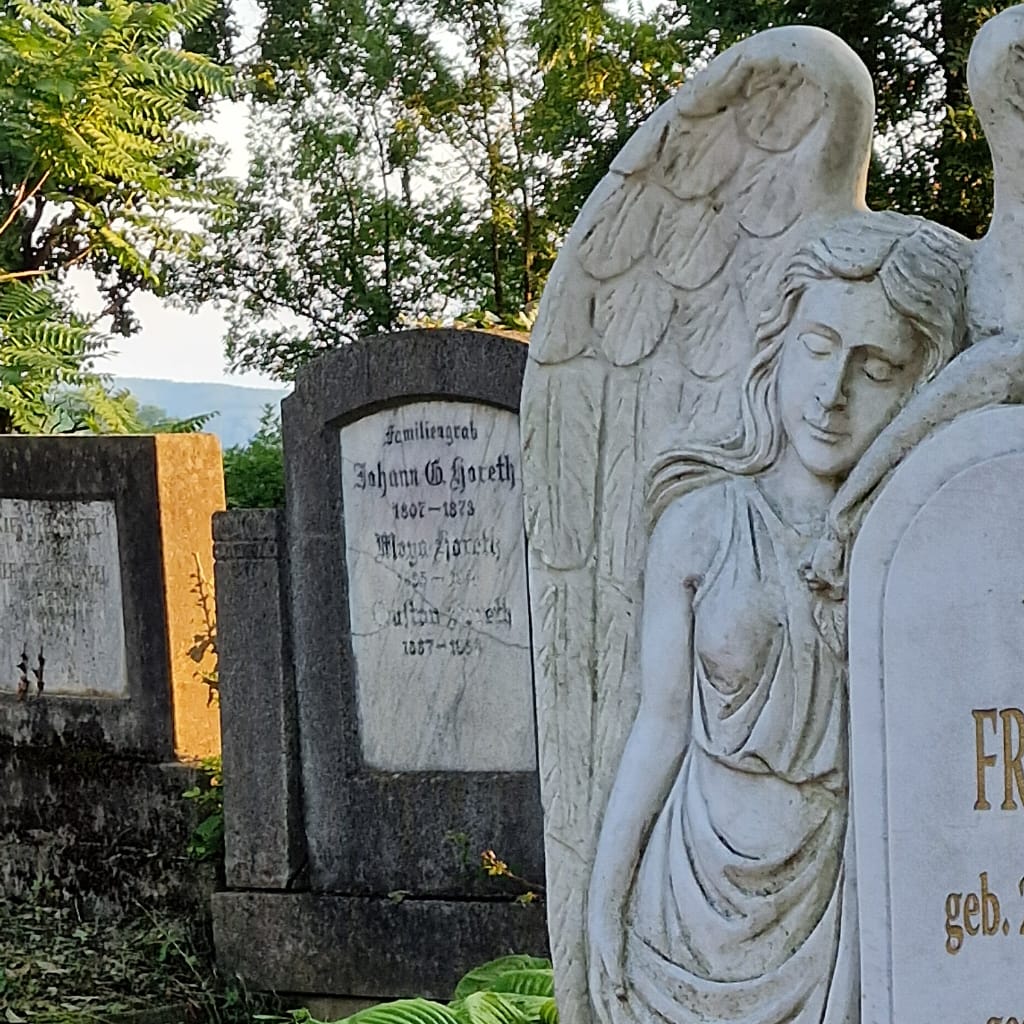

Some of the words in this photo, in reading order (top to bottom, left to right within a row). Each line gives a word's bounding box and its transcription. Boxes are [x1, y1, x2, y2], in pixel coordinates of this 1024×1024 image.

[383, 420, 478, 446] Familiengrab
[354, 461, 419, 498] Johann
[944, 872, 1010, 955] geb.
